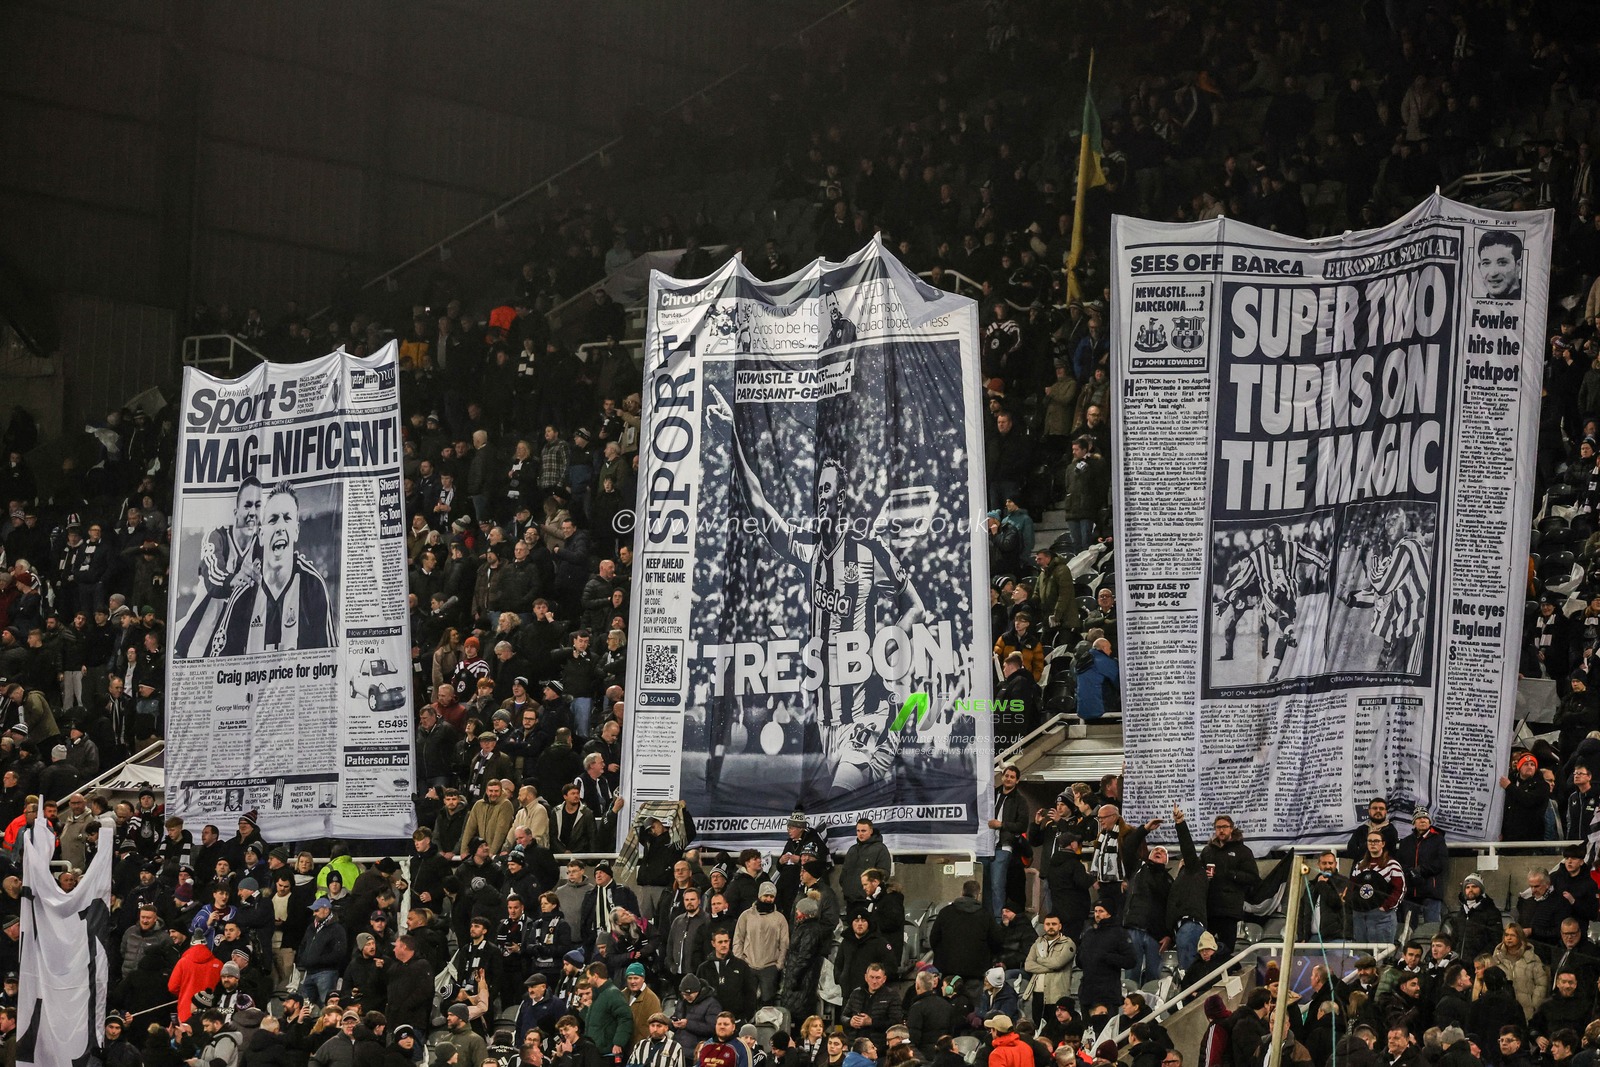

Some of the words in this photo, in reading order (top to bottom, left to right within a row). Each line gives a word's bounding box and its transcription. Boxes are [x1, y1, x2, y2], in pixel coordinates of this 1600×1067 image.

[1400, 238, 1455, 263] SPECIAL
[1131, 254, 1179, 272] SEES
[1183, 254, 1223, 271] OFF
[1232, 254, 1304, 277] BARCA
[1231, 285, 1359, 359] SUPER
[1365, 265, 1447, 348] TINO
[1472, 309, 1518, 330] Fowler
[774, 324, 784, 334] to
[786, 322, 800, 334] be
[857, 320, 884, 333] squad
[769, 338, 806, 349] James'
[1468, 334, 1493, 355] hits
[1497, 335, 1520, 355] the
[1464, 360, 1519, 385] jackpot
[279, 380, 297, 412] 5
[1230, 354, 1375, 436] TURNS
[1379, 343, 1441, 419] ON
[187, 383, 277, 434] Sport
[184, 416, 399, 484] MAG-NIFICENT!
[648, 334, 696, 544] SPORT
[1221, 438, 1309, 511] THE
[1315, 420, 1441, 506] MAGIC
[646, 558, 660, 568] KEEP
[662, 558, 684, 568] AHEAD
[645, 573, 653, 582] OF
[654, 573, 665, 582] THE
[667, 573, 686, 583] GAME
[1452, 599, 1476, 615] Mac
[1478, 604, 1505, 620] eyes
[1453, 620, 1502, 640] England
[703, 625, 824, 697] TRÈS
[836, 620, 955, 686] BON
[217, 669, 242, 686] Craig
[245, 670, 267, 685] pays
[269, 667, 293, 683] price
[296, 664, 310, 678] for
[313, 662, 338, 679] glory
[378, 720, 408, 728] £5495
[347, 756, 389, 765] Patterson
[392, 755, 408, 764] Ford
[1219, 756, 1253, 764] Surrounded
[696, 819, 749, 831] HISTORIC
[750, 816, 810, 830] CHAMPS
[856, 808, 888, 822] NIGHT
[892, 806, 913, 818] FOR
[917, 806, 963, 818] UNITED
